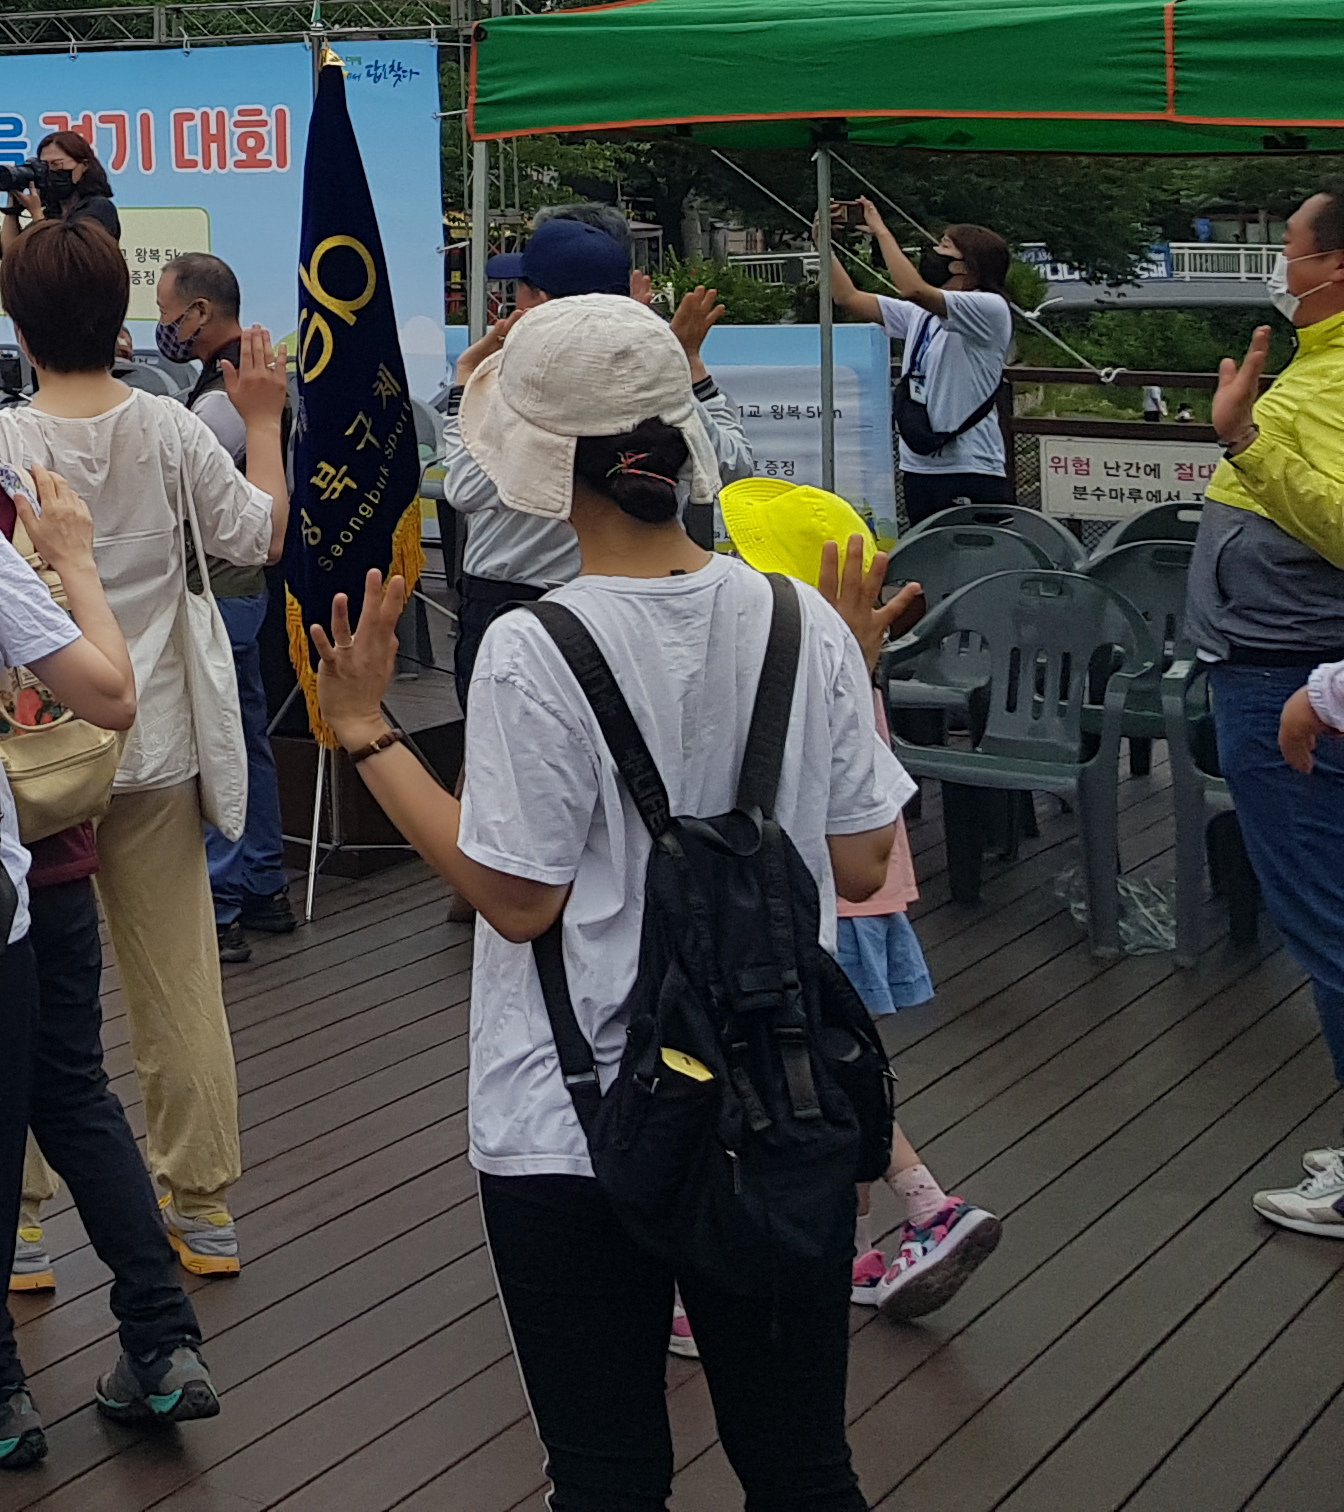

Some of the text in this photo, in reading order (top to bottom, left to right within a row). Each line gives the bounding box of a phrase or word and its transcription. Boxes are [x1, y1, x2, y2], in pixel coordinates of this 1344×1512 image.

[172, 107, 288, 171] 대회
[134, 247, 161, 263] 왕복
[130, 269, 155, 286] 증정
[770, 404, 802, 420] 왕복
[764, 460, 795, 477] 증정
[1048, 455, 1091, 477] 위험
[1103, 460, 1161, 480] 난간에
[1072, 484, 1182, 505] 분수마루에서
[317, 464, 391, 572] Seongbuk
